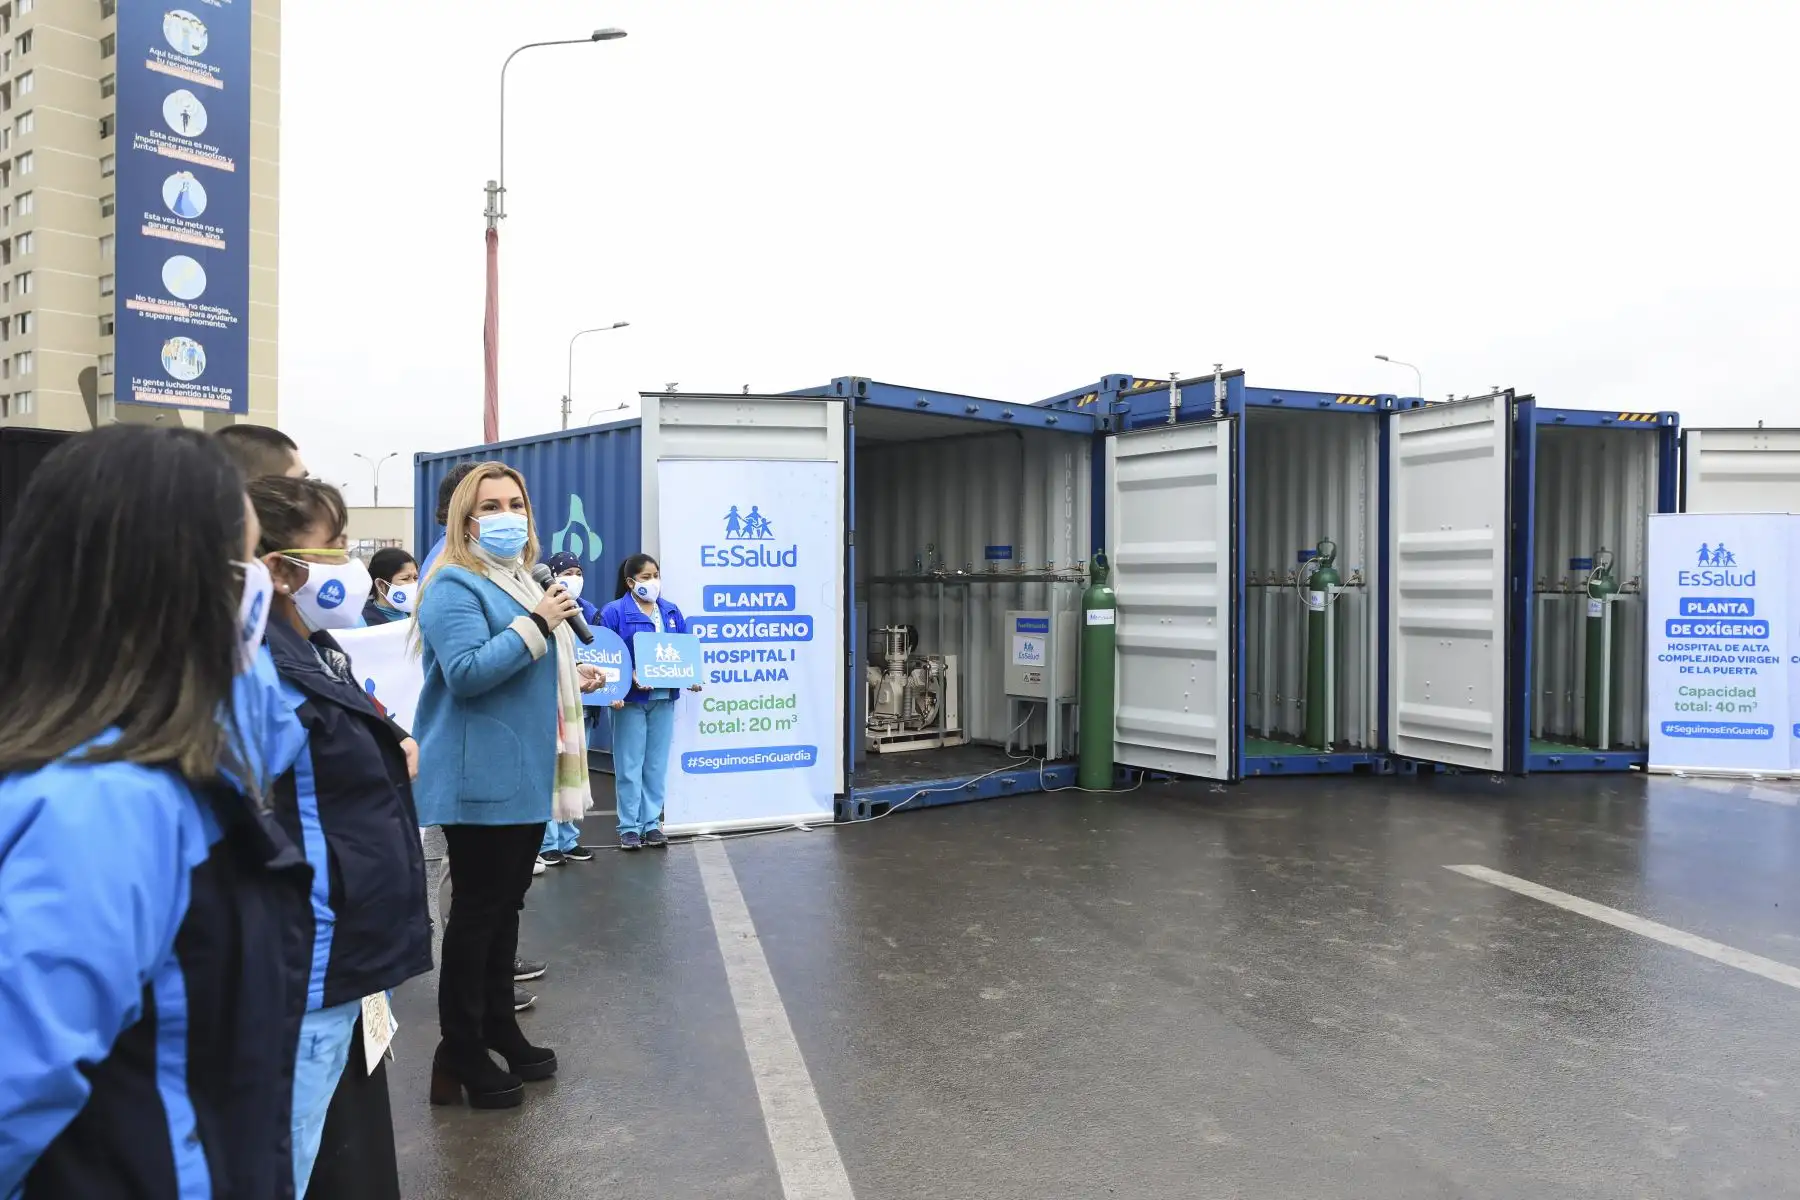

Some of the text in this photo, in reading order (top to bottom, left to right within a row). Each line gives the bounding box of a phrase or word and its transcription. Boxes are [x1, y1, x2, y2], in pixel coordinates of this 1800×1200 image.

[209, 64, 220, 74] por
[133, 141, 157, 153] juntos
[135, 133, 177, 149] importante
[178, 145, 194, 154] para
[195, 149, 226, 161] nosotros
[150, 130, 166, 140] Esta
[168, 135, 192, 146] carrera
[204, 144, 219, 153] muy
[144, 212, 161, 221] Esta
[162, 216, 175, 225] vez
[177, 218, 184, 226] la
[185, 221, 203, 230] meta
[148, 221, 168, 230] ganar
[205, 232, 220, 240] sino
[135, 294, 146, 302] No
[145, 311, 172, 321] superar
[174, 315, 190, 323] este
[189, 311, 237, 323] para ayudarte
[132, 384, 156, 394] inspira
[174, 389, 202, 398] sentido
[208, 391, 215, 399] la
[143, 378, 164, 387] gente
[165, 380, 201, 391] luchadora
[219, 387, 232, 395] que
[701, 544, 798, 567] EsSalud
[1678, 569, 1756, 587] EsSalud
[713, 592, 788, 607] PLANTA
[1687, 602, 1749, 614] PLANTA
[692, 618, 809, 639] DE OXÍGENO
[1671, 620, 1766, 636] DE OXÍGENO
[1667, 643, 1770, 653] HOSPITAL DE ALTA
[577, 647, 622, 665] EsSalud
[703, 648, 796, 664] HOSPITAL I
[1657, 654, 1736, 664] COMPLEJIDAD
[1737, 655, 1780, 664] VIRGEN
[644, 664, 694, 679] EsSalud
[710, 668, 789, 683] SULLANA
[1679, 665, 1758, 675] DE LA PUERTA
[1678, 685, 1757, 699] Capacidad
[702, 693, 796, 715] Capacidad
[1674, 701, 1712, 712] total:
[1715, 701, 1736, 713] 40
[698, 717, 745, 735] total:
[749, 716, 772, 732] 20
[1665, 724, 1769, 736] #SeguimosEnGuardia
[687, 750, 811, 770] #SeguimosEnGuardia
